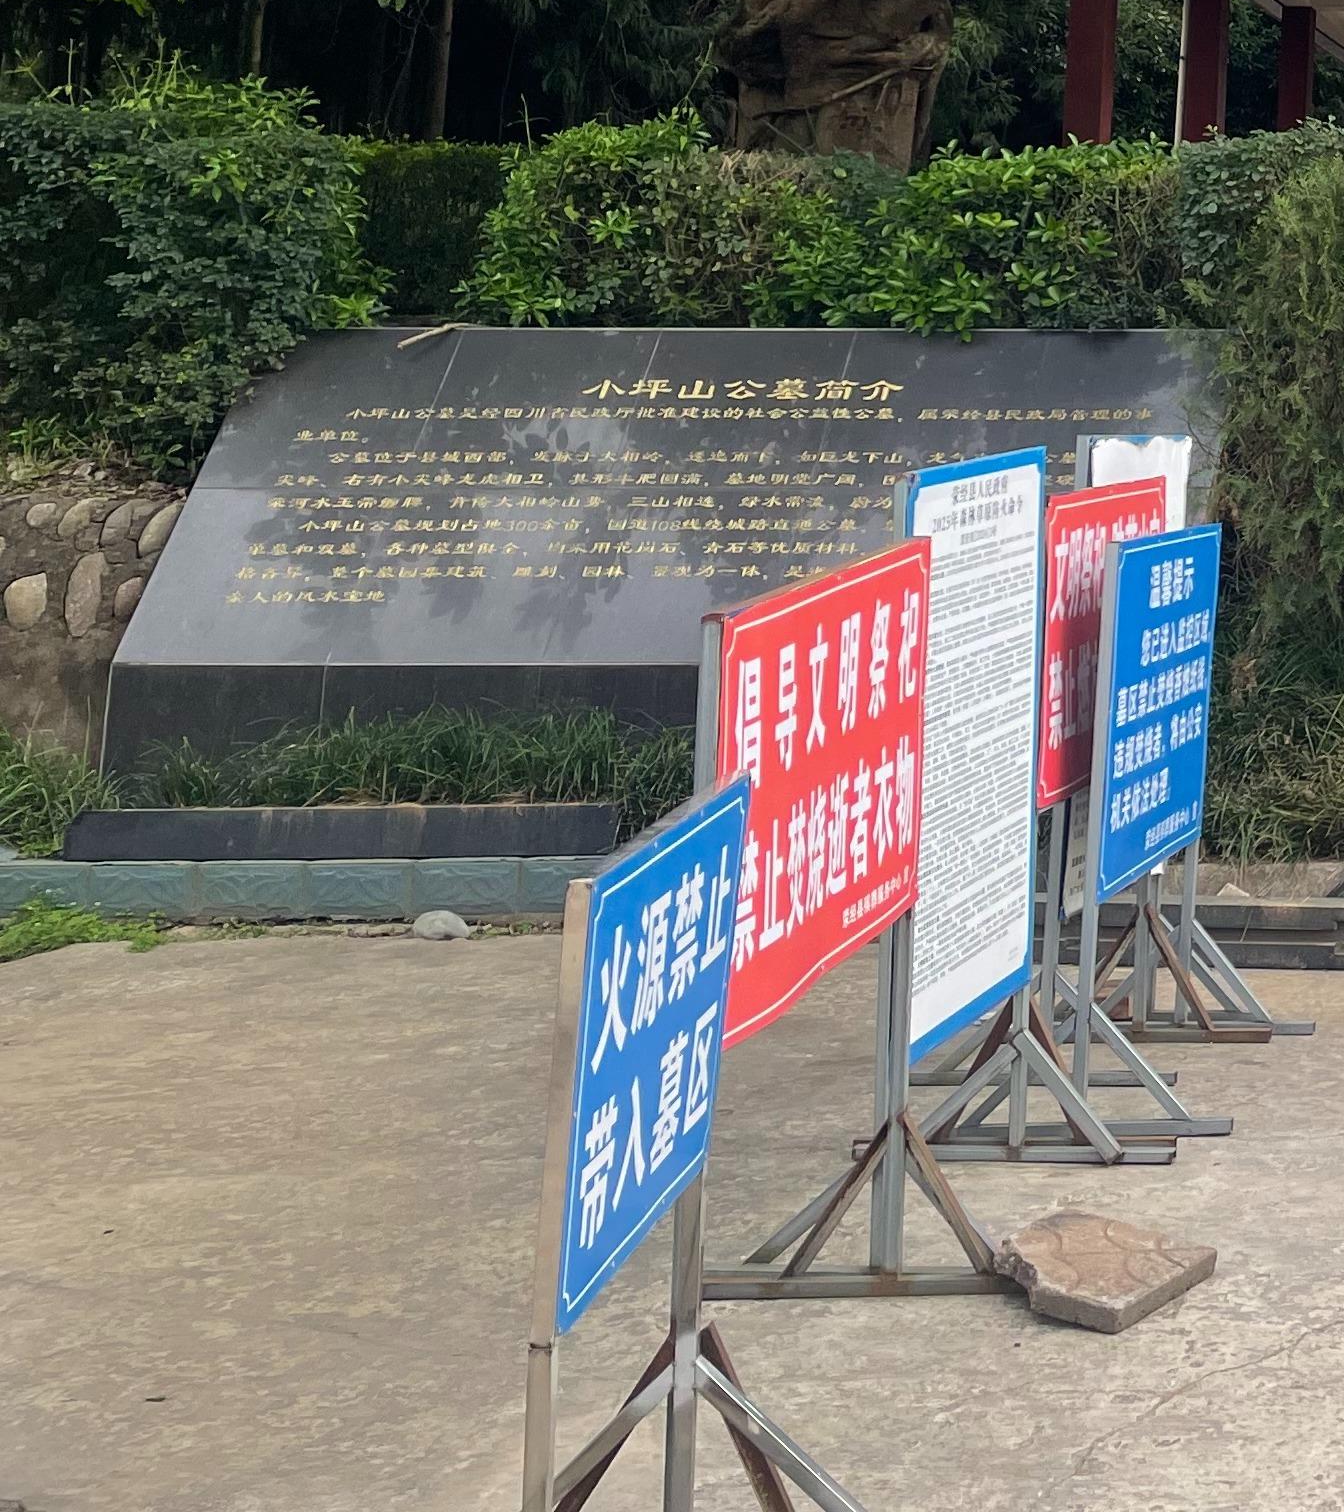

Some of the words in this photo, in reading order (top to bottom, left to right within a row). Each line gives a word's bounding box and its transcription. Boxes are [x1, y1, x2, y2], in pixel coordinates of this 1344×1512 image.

[582, 378, 905, 402] 小坪山公墓简介
[733, 587, 920, 790] 倡导文明祭祀
[1149, 556, 1195, 609] 温馨提示
[590, 844, 732, 1075] 火源禁止
[730, 734, 915, 972] 禁止焚烧逝者衣物
[578, 1000, 718, 1250] 带入墓区
